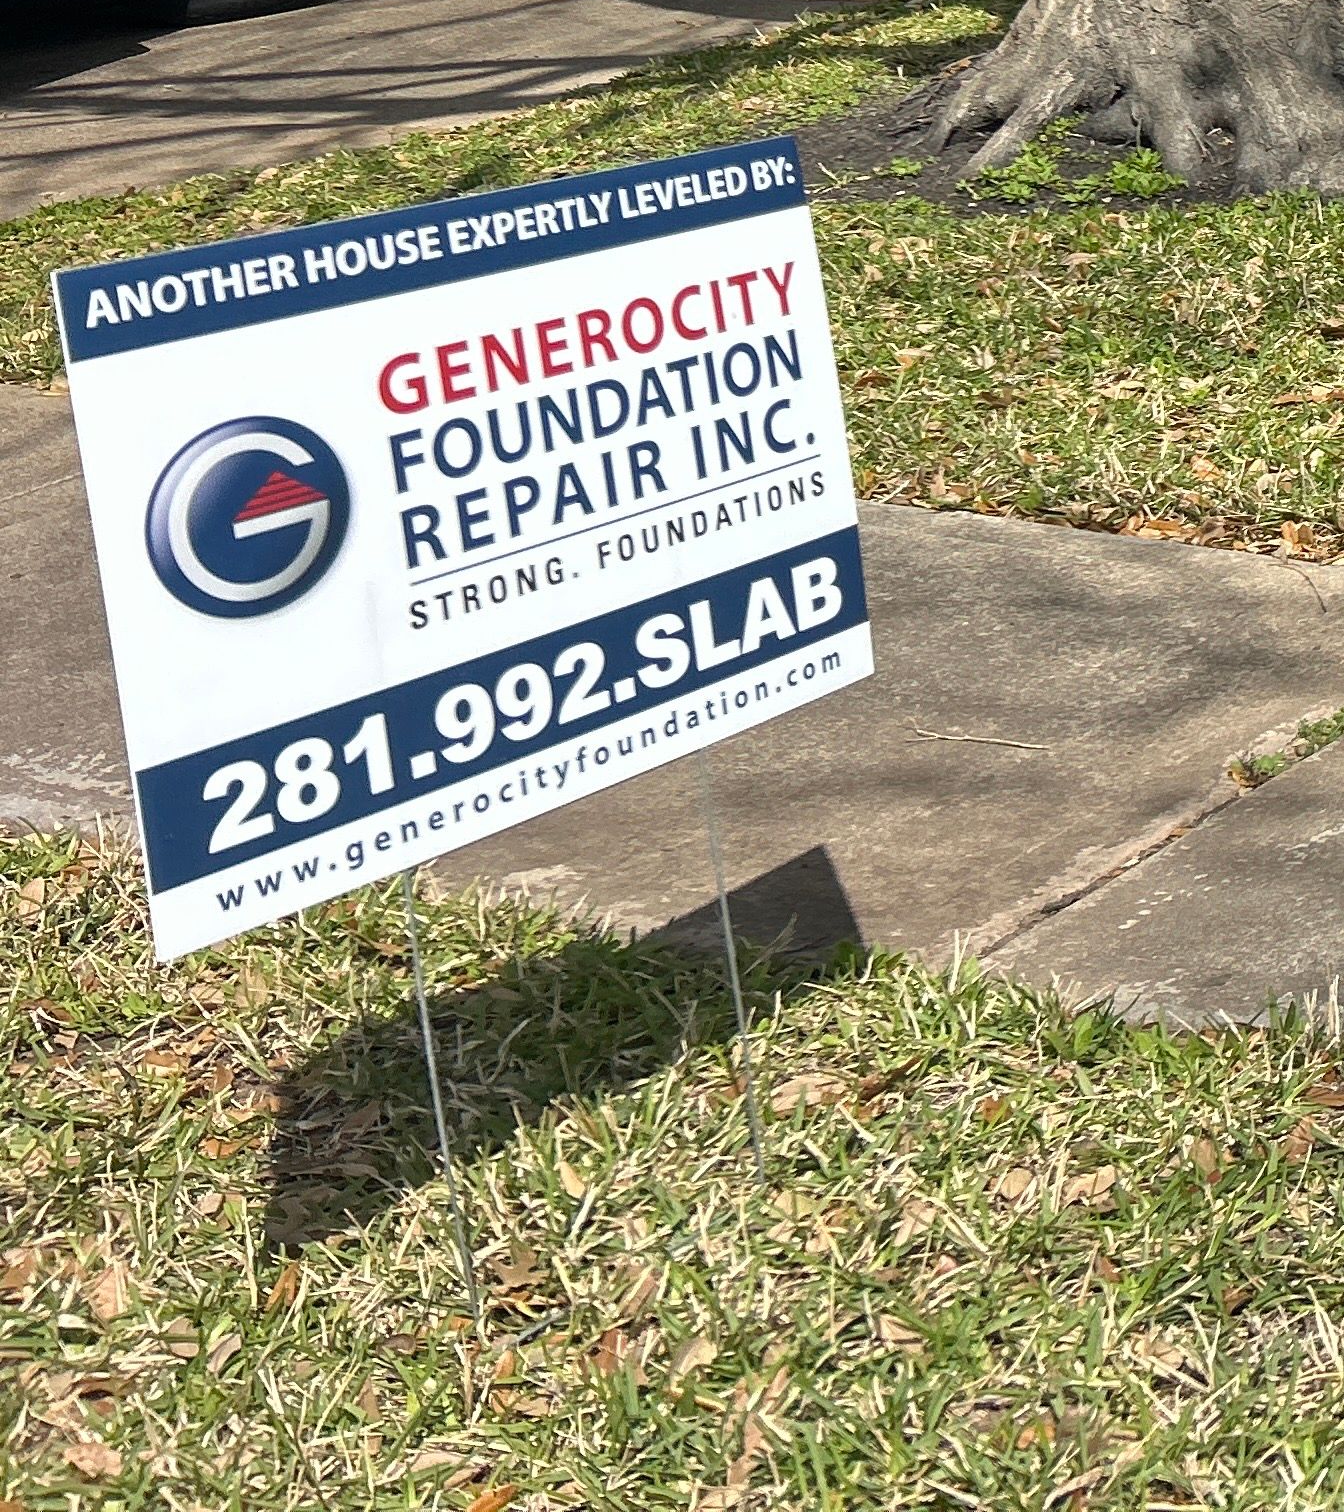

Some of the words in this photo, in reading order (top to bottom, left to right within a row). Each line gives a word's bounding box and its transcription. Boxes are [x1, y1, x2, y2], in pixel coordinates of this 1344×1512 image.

[85, 253, 300, 329] ANOTHER
[303, 224, 443, 284] HOUSE
[446, 190, 612, 255] EXPERTLY
[616, 166, 749, 219] LEVELED
[750, 156, 796, 192] BY:
[376, 261, 795, 415] GENEROCITY
[388, 328, 804, 494] FOUNDATION
[399, 438, 668, 569] REPAIR
[690, 398, 817, 480] INC.
[410, 555, 580, 631] STRONG.
[596, 470, 826, 569] FOUNDATIONS
[202, 555, 844, 855] 281.992.SLAB
[214, 649, 842, 912] www.generocityfoundation.com
